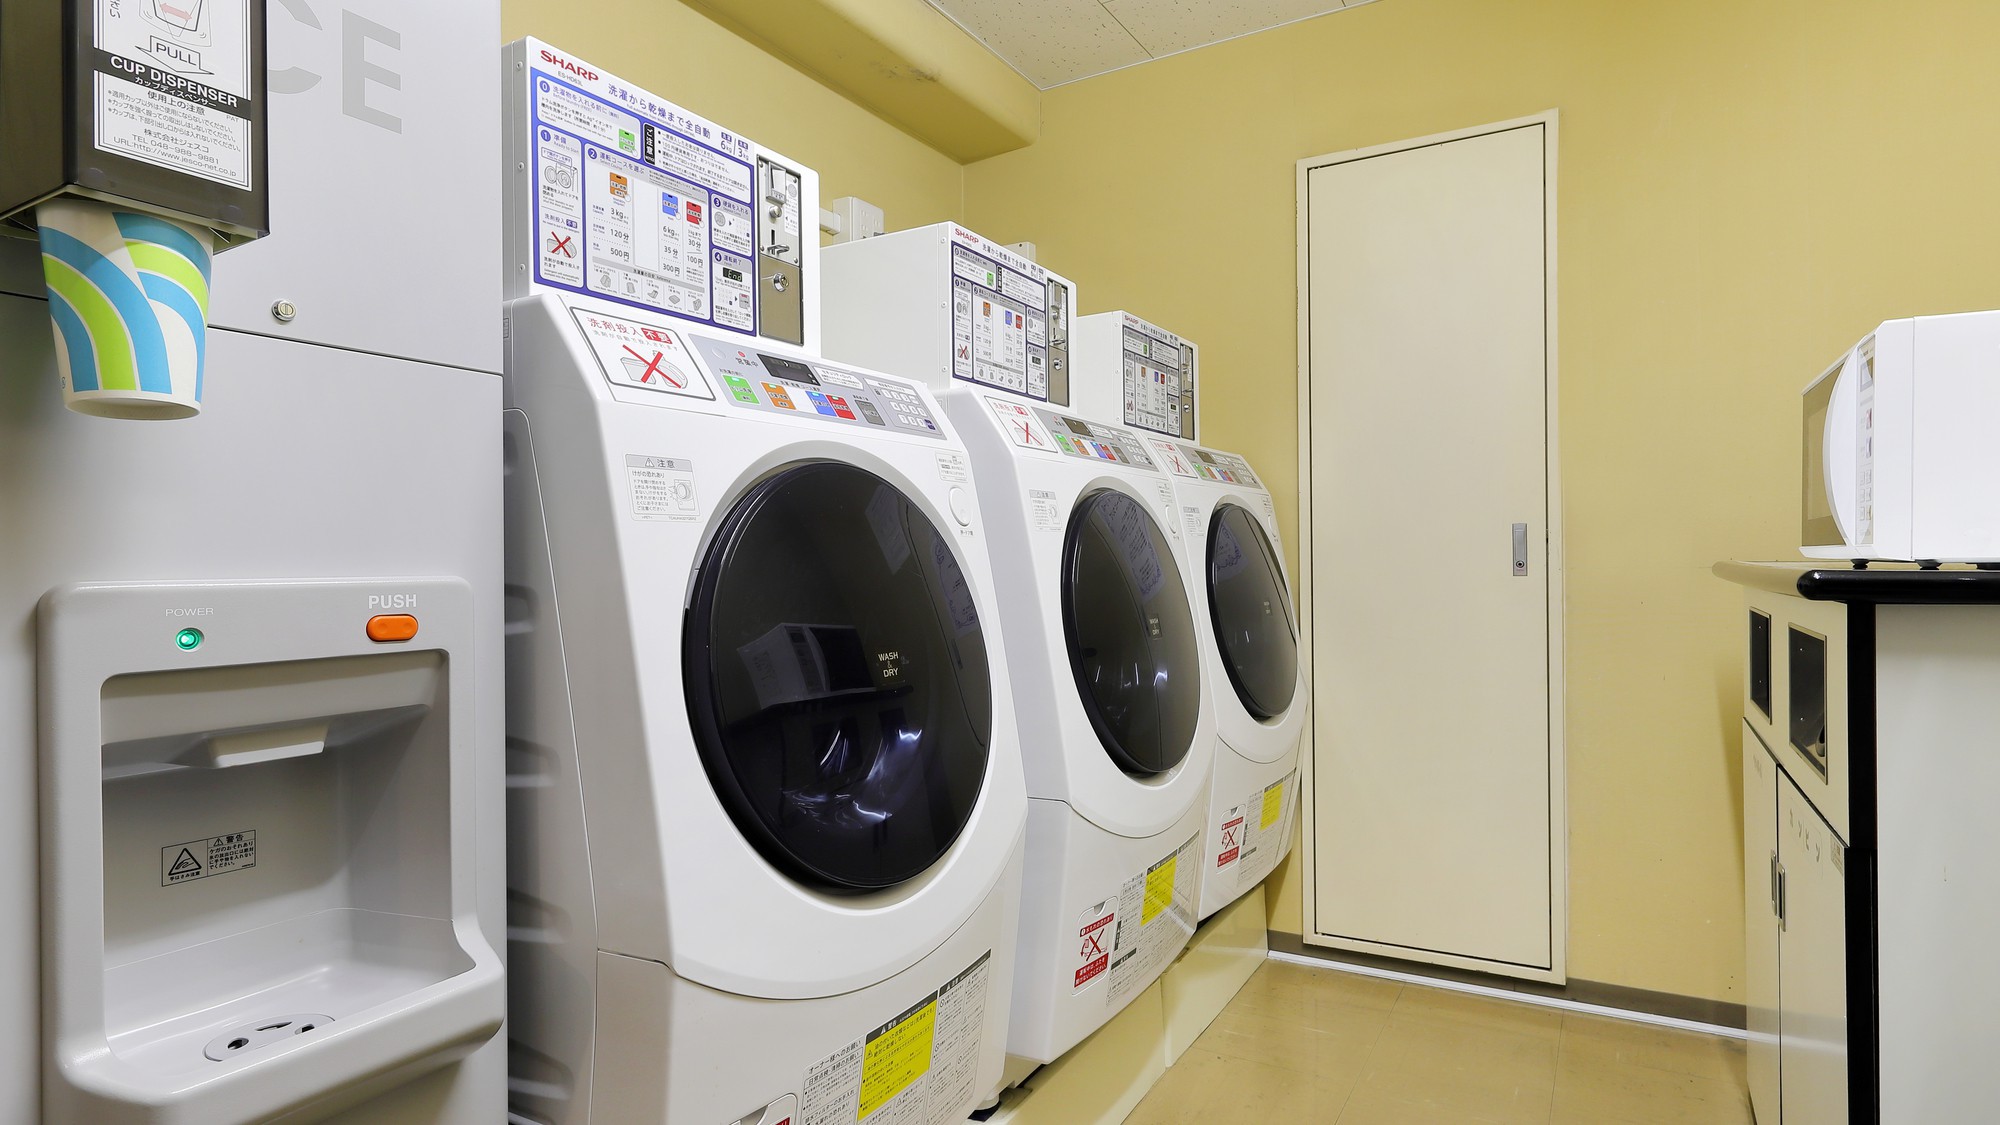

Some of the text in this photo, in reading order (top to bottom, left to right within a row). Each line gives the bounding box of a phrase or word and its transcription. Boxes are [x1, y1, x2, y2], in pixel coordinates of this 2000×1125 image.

[156, 43, 196, 65] PULL
[540, 50, 598, 81] SHARP
[110, 56, 238, 108] CUP DISPENSER
[135, 76, 217, 107] カップディスペンサー
[148, 90, 205, 116] 使用上の注意
[608, 83, 711, 140] 洗濯から乾燥まで全自動
[226, 115, 239, 123] PAT
[144, 128, 210, 154] 株式会社ジェスコ
[132, 134, 220, 165] TEL 048-988-9881
[600, 152, 645, 175] 運転コースを選ぶ
[611, 229, 629, 241] 120分
[955, 228, 979, 243] SHARP
[688, 238, 701, 250] 30分
[611, 248, 630, 260] 500円
[664, 246, 678, 257] 35分
[687, 255, 703, 267] 100円
[724, 255, 742, 266] 運転終了
[663, 263, 680, 275] 300円
[728, 270, 742, 282] End
[587, 317, 672, 344] 洗剤投入 不要
[657, 459, 676, 468] 注意
[368, 594, 417, 609] PUSH
[165, 607, 214, 617] POWER
[878, 652, 899, 662] WASH
[883, 668, 898, 677] DRY
[226, 834, 244, 844] 警告
[209, 841, 253, 854] ケガのおそれあり
[809, 1039, 861, 1074] オーナー様へのお願い
